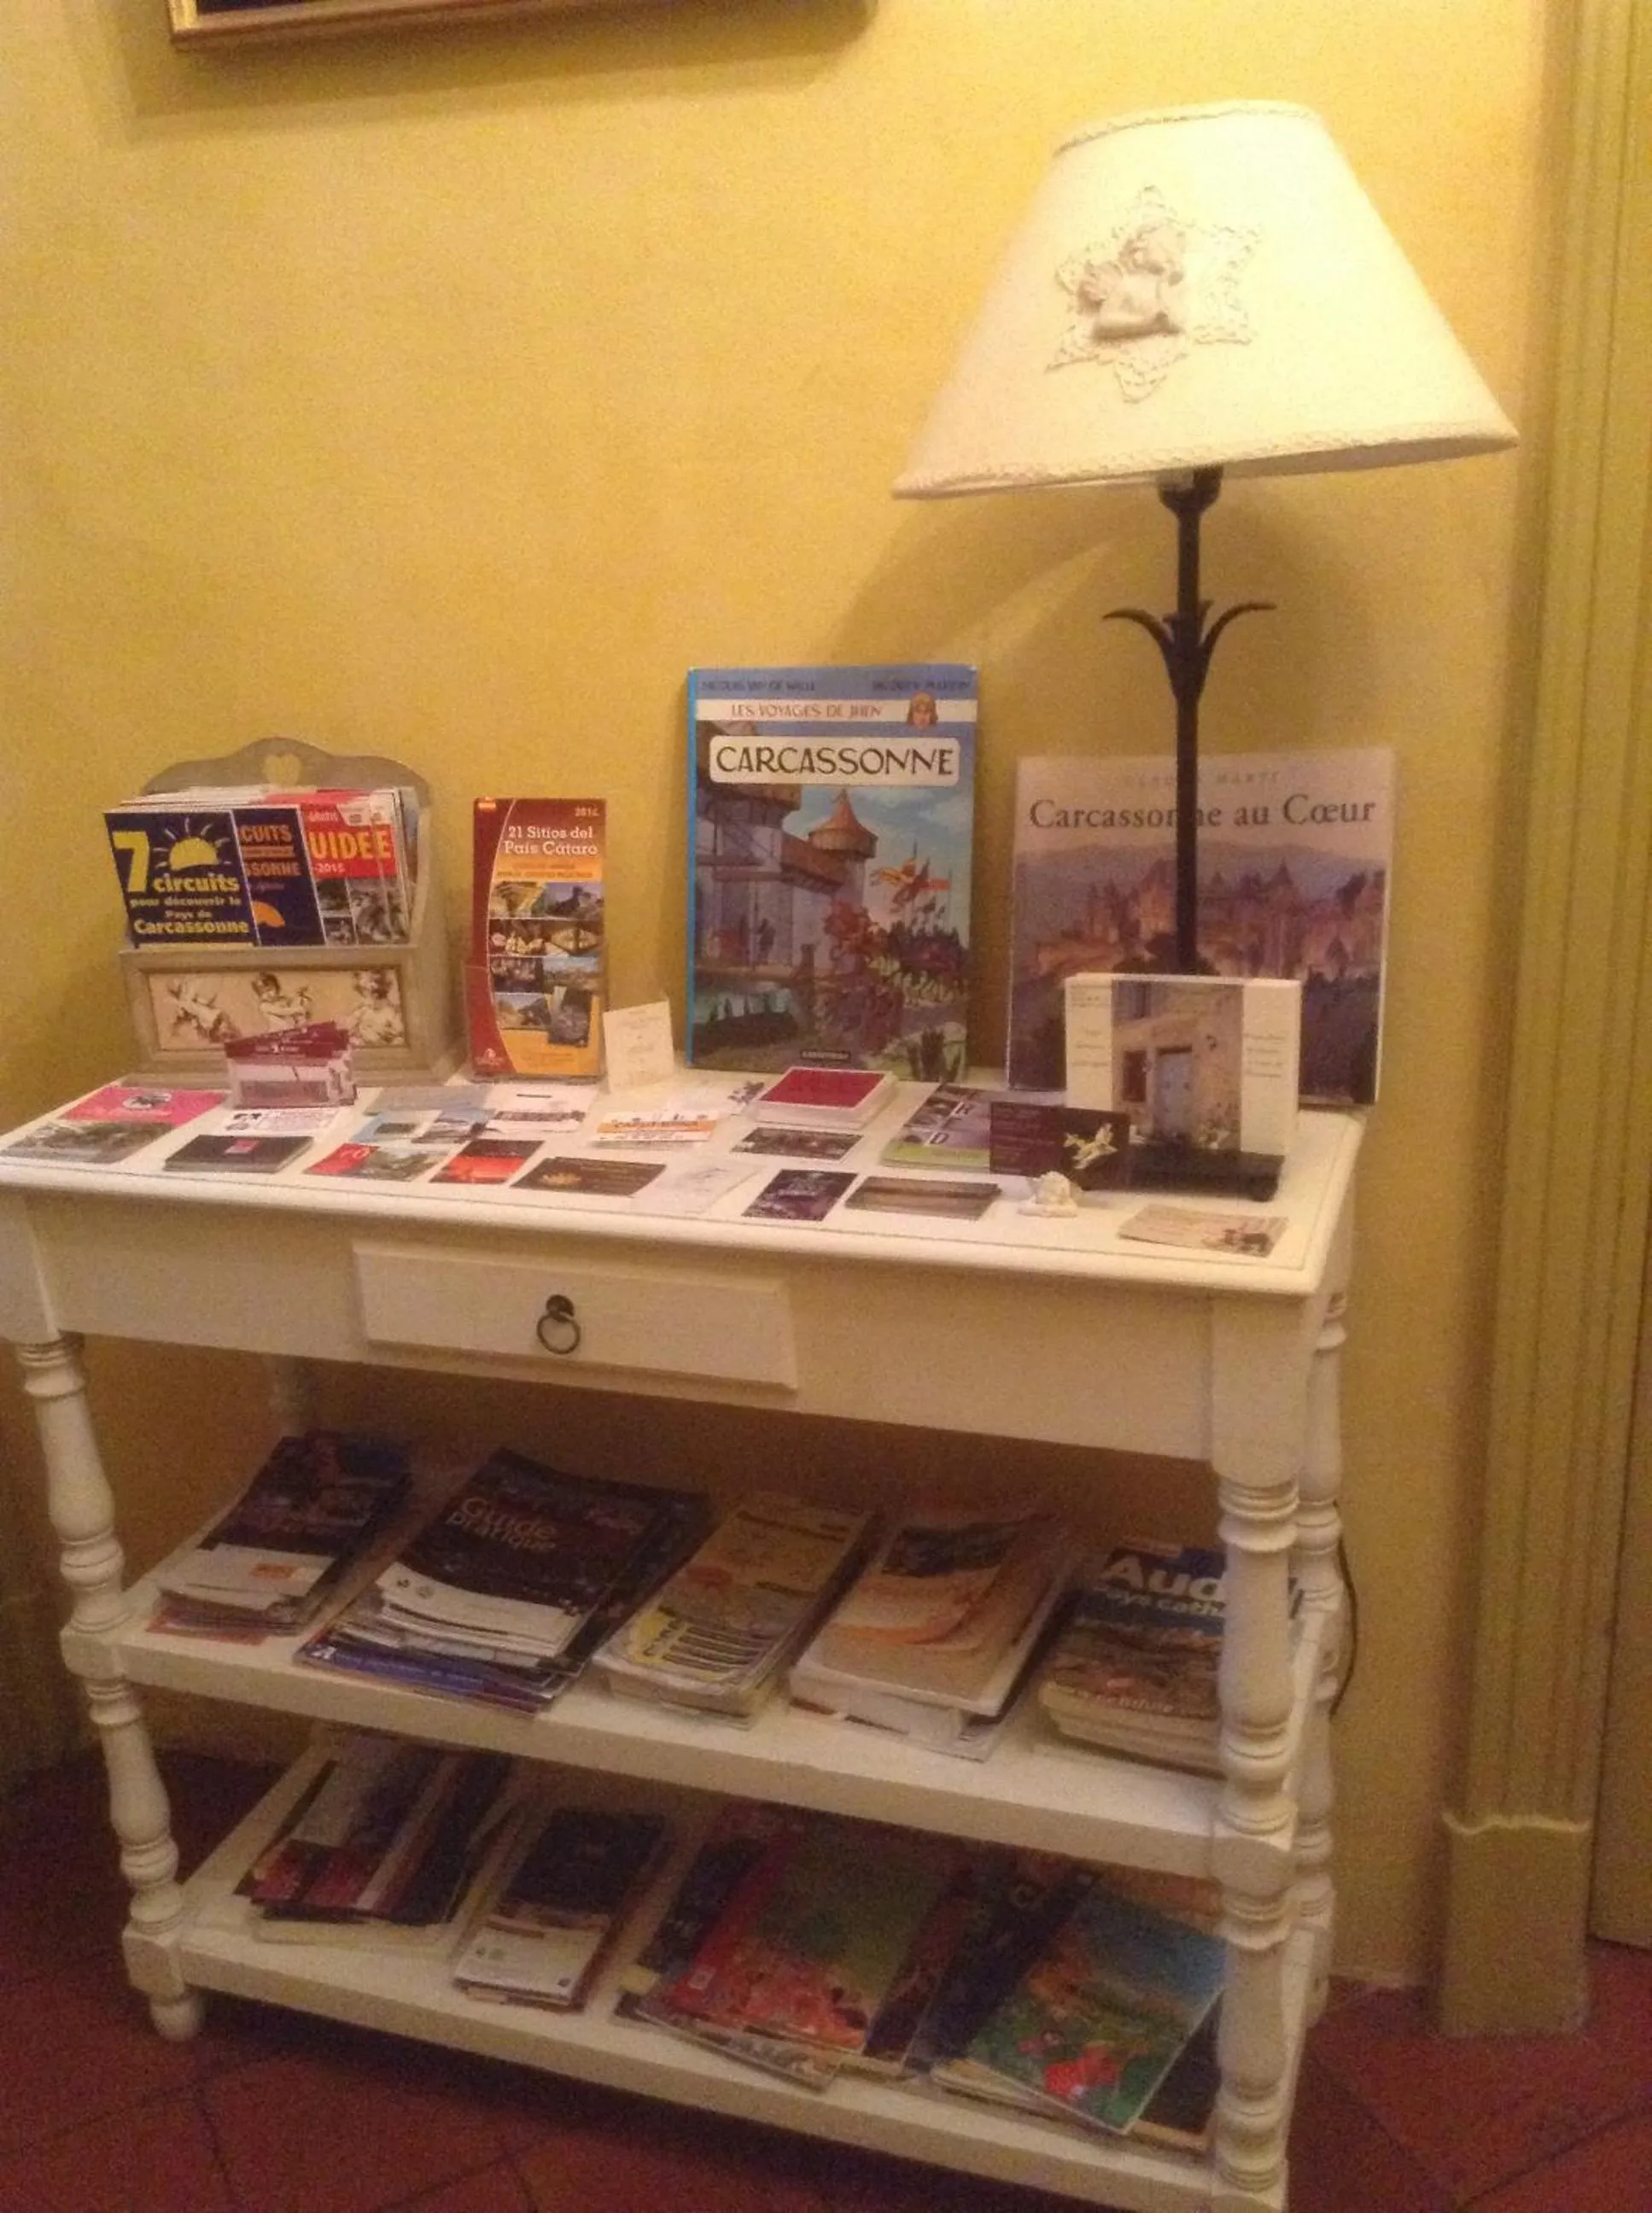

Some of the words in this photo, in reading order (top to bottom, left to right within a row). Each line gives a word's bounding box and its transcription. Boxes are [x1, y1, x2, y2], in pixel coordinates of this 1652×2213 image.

[731, 704, 755, 717] LES
[758, 704, 822, 718] VOYAGES
[716, 746, 954, 775] CARCASSONNE
[1234, 805, 1270, 826] au
[1284, 793, 1377, 825] Cœur
[508, 826, 522, 838] 21
[527, 826, 567, 838] Sitios
[570, 826, 593, 838] del
[112, 831, 149, 892] 7
[153, 873, 241, 893] circuits
[133, 918, 250, 935] Carcassonne
[461, 1496, 557, 1541] Guide
